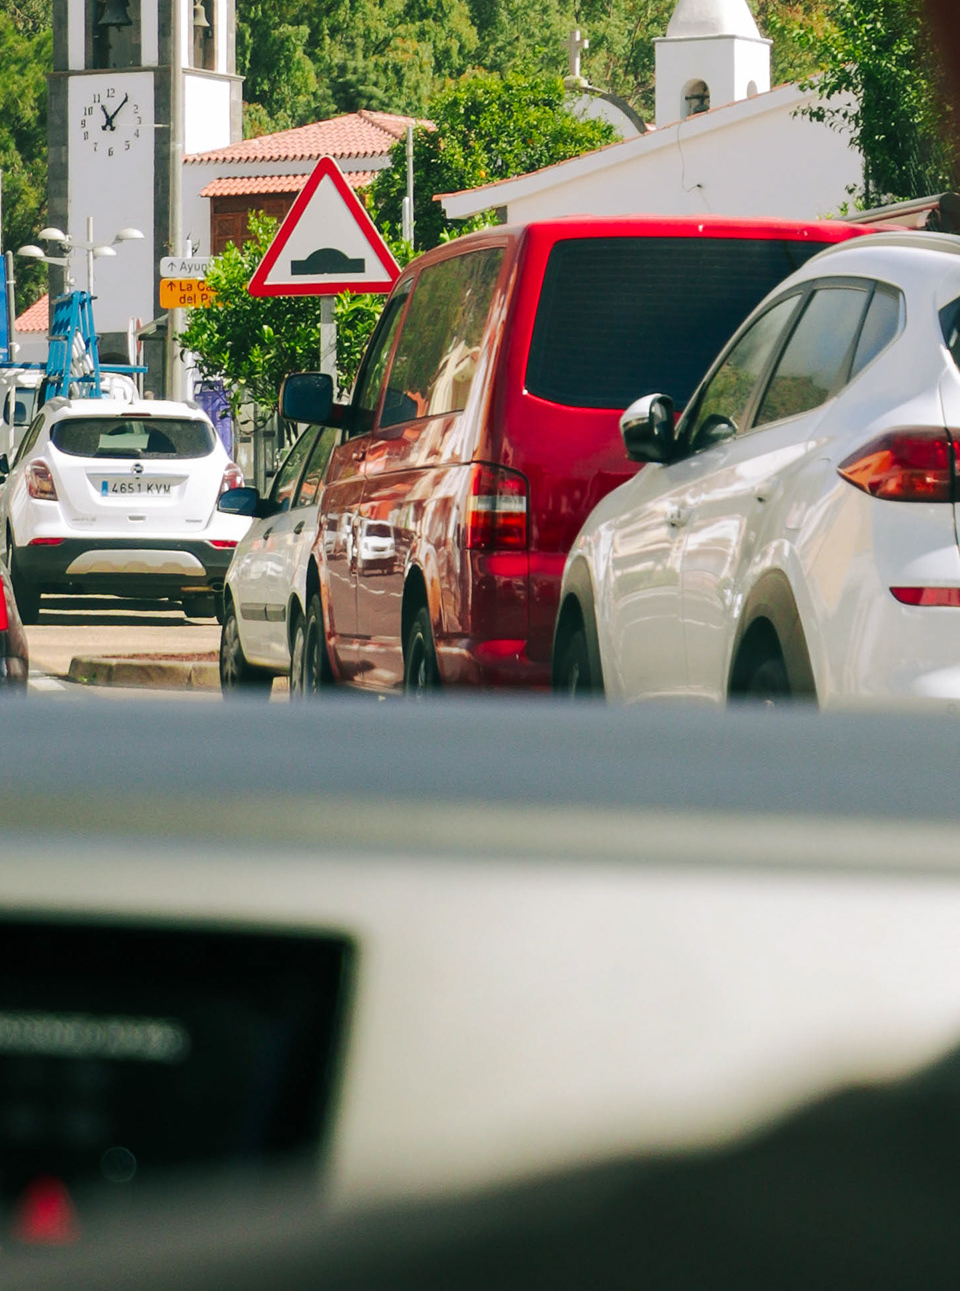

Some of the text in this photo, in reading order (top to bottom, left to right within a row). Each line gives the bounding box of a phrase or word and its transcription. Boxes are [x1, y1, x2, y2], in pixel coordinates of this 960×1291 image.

[106, 88, 115, 98] 12
[93, 94, 101, 103] 11
[84, 106, 93, 116] 10
[133, 104, 139, 114] 2
[81, 119, 86, 128] 9
[137, 116, 142, 125] 3
[84, 131, 89, 140] 8
[135, 129, 140, 138] 4
[93, 142, 98, 152] 7
[125, 140, 130, 150] 5
[108, 147, 113, 157] 6
[179, 281, 192, 292] La
[179, 294, 196, 304] del
[112, 483, 171, 494] 4651 KVM
